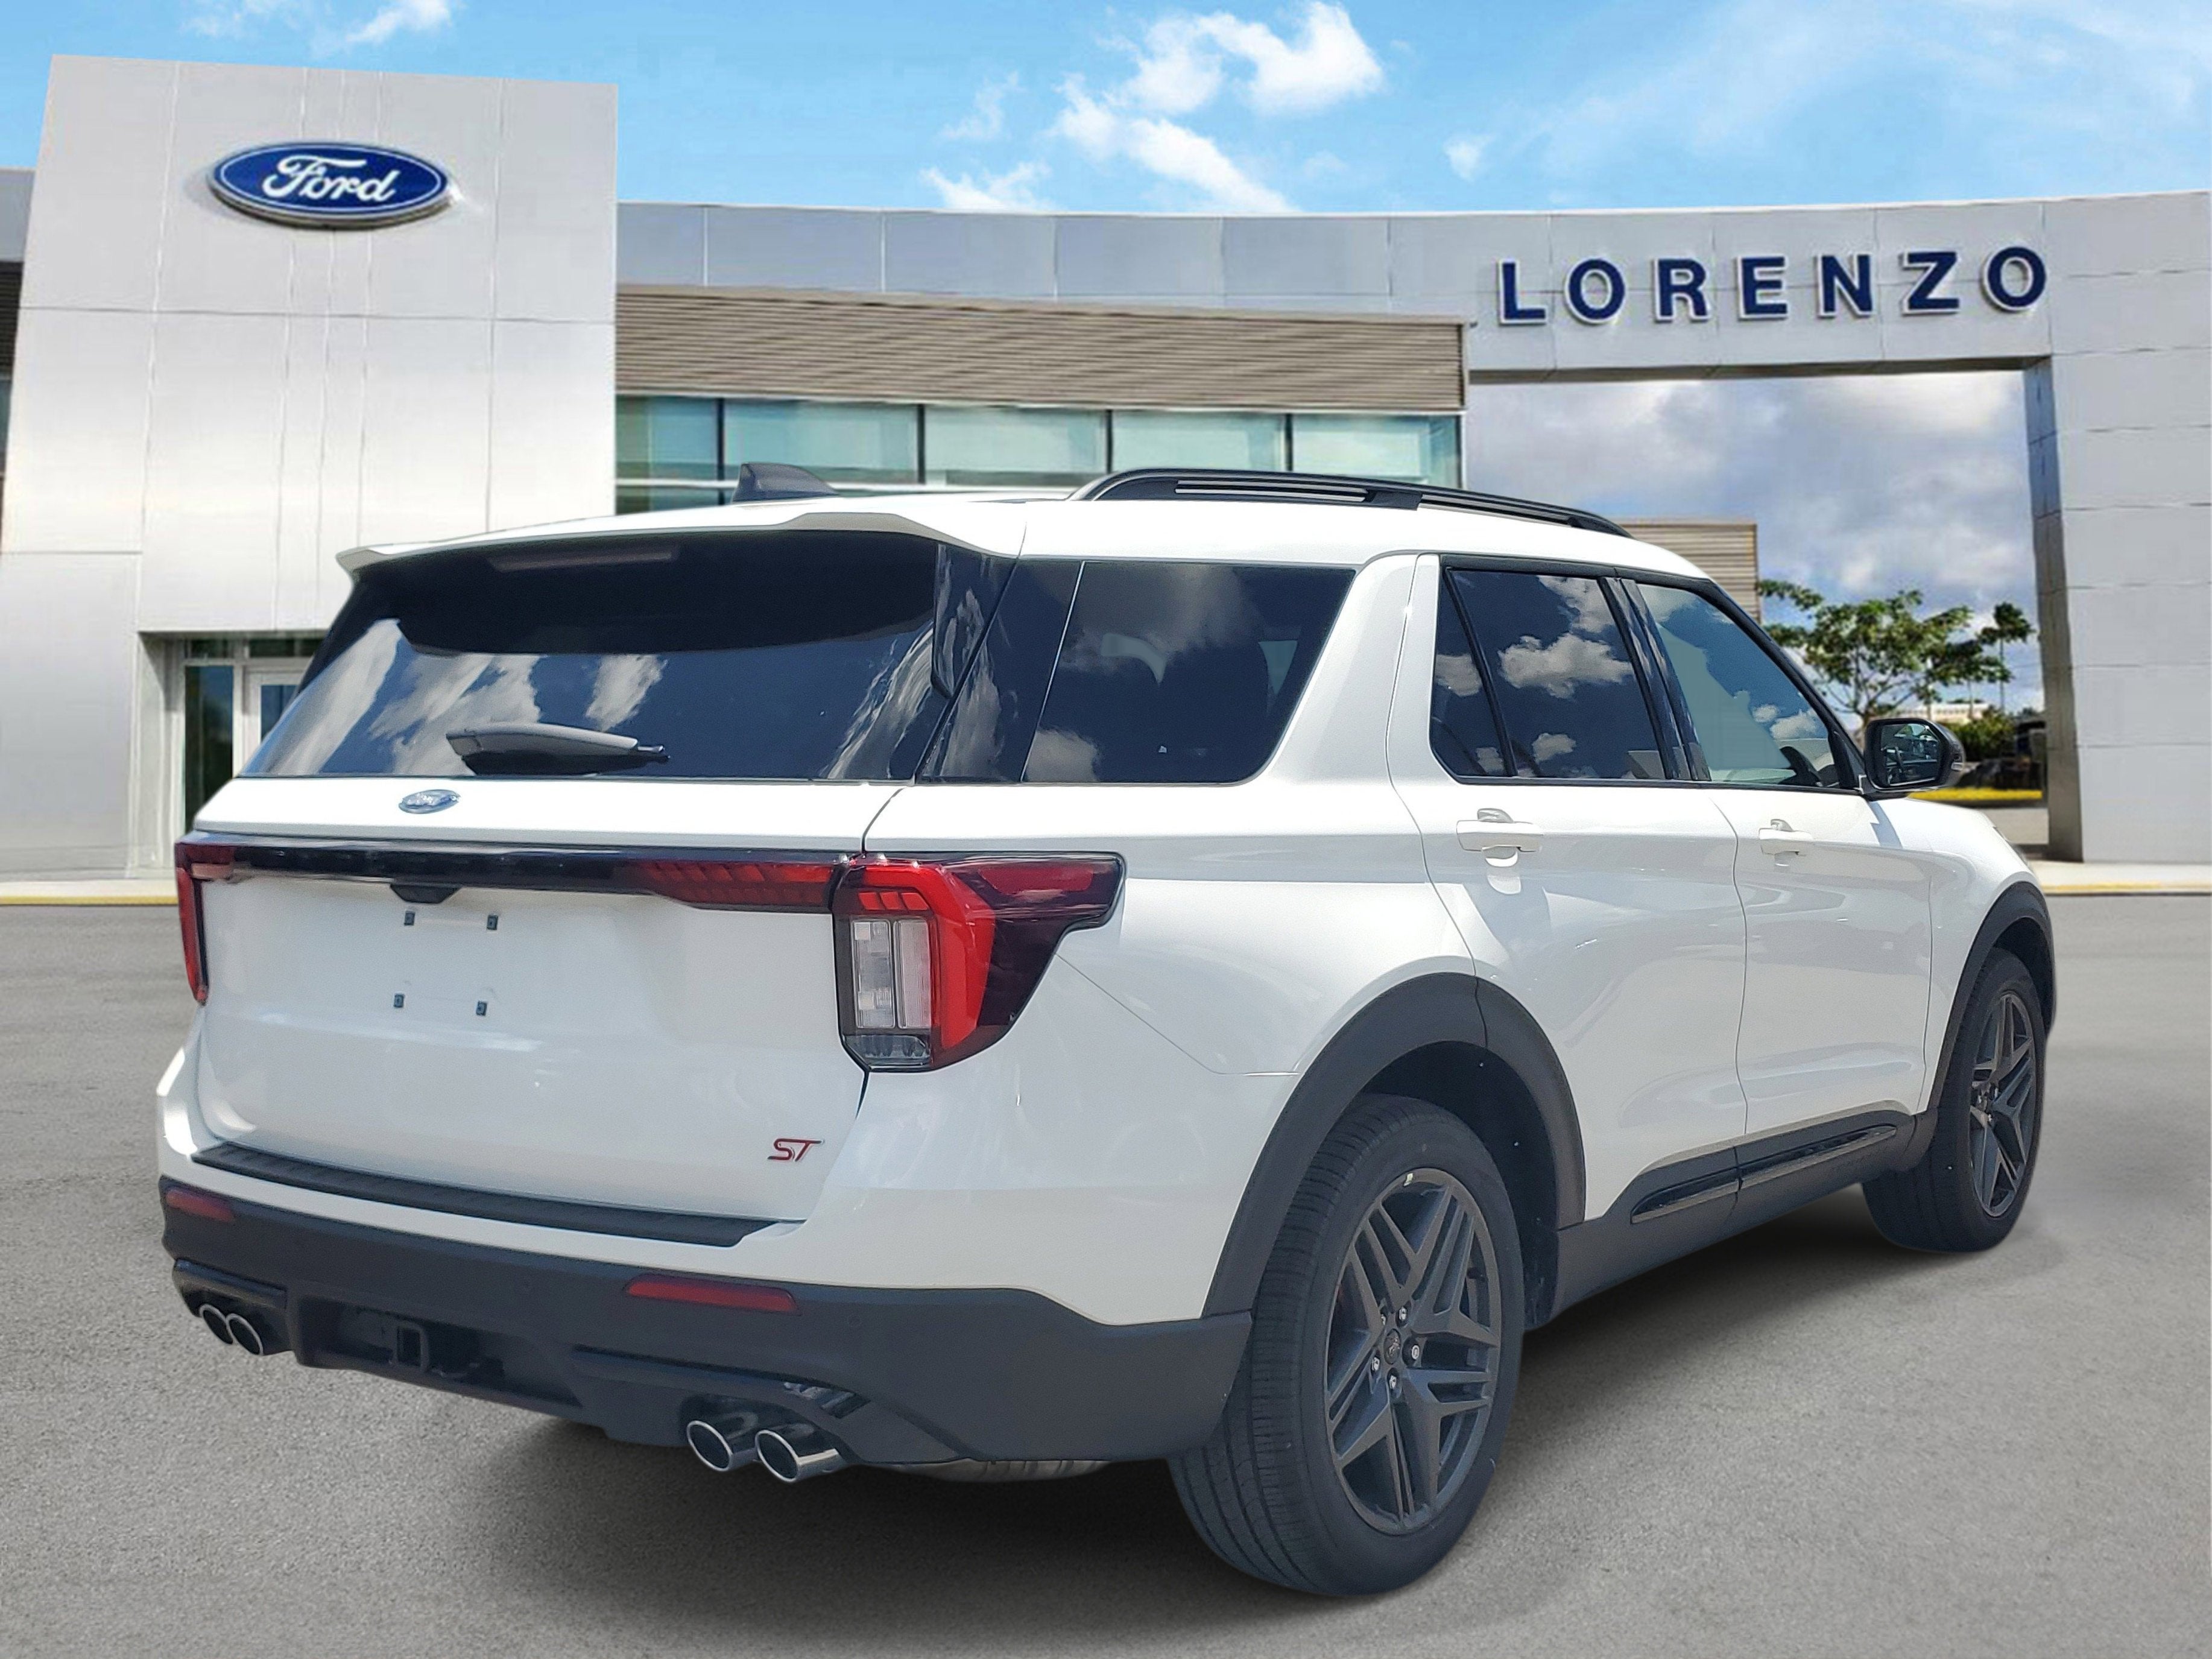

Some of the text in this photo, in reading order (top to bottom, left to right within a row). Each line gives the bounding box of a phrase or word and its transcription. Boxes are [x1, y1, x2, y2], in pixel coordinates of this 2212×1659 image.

[262, 154, 400, 202] Ford
[1497, 246, 2047, 323] LORENZO
[767, 1138, 823, 1161] ST
